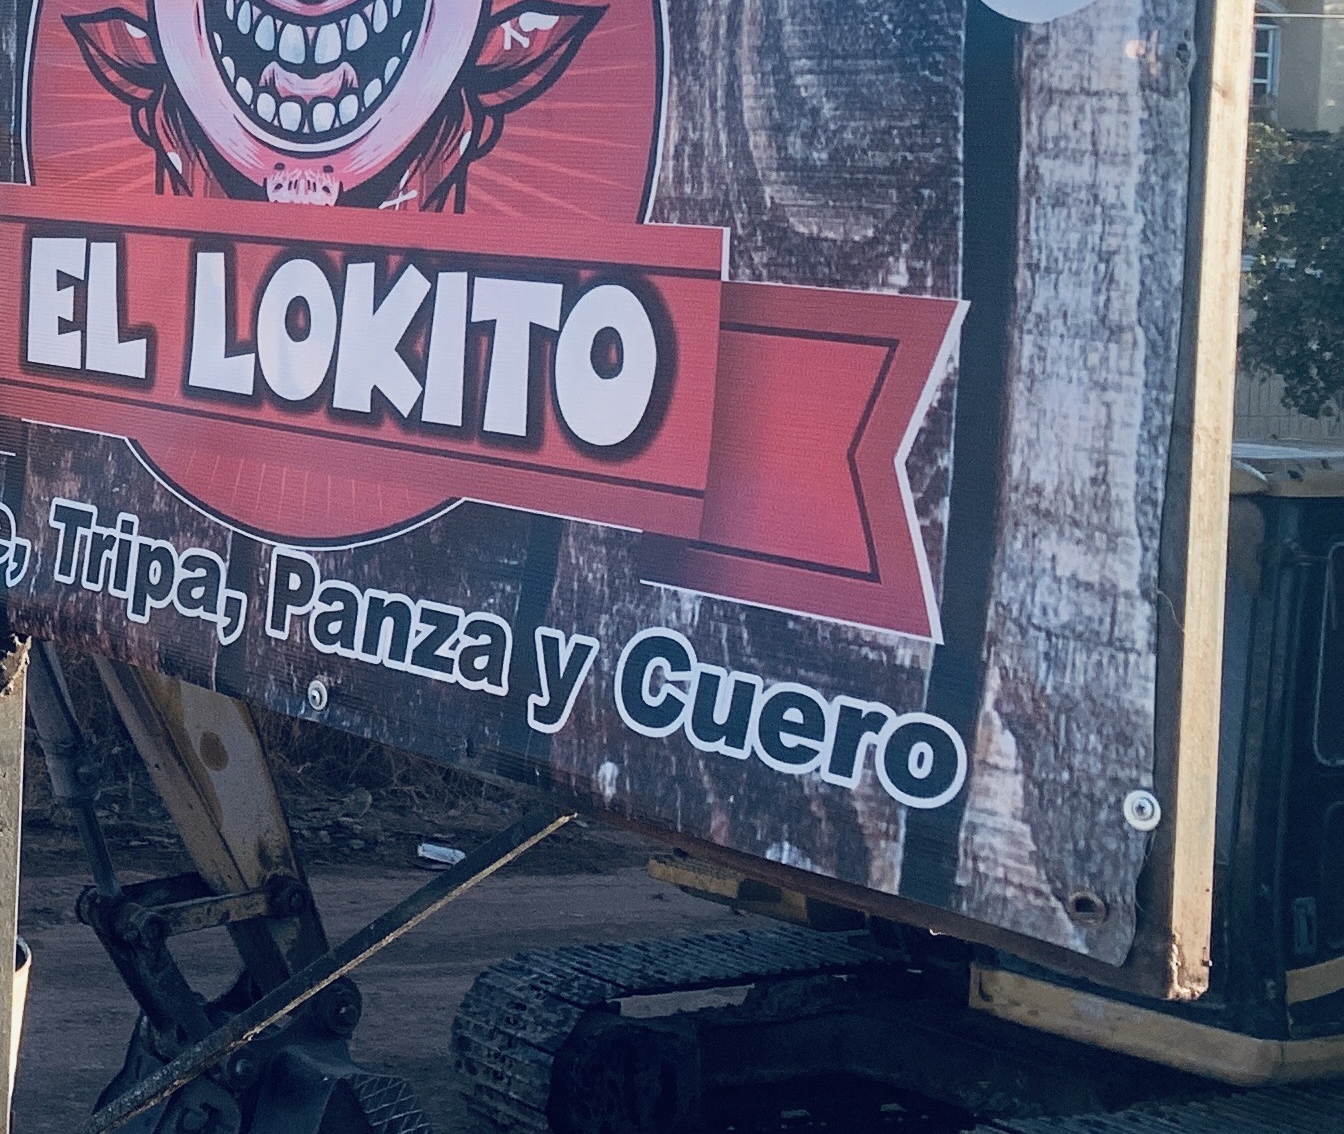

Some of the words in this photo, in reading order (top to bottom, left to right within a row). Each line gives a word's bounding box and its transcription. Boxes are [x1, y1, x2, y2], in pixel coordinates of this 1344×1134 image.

[25, 236, 148, 381] EL
[187, 250, 658, 447] LOKITO
[50, 499, 246, 643] Tripa,
[266, 546, 512, 694] Panza
[527, 629, 598, 732] y
[615, 628, 966, 807] Cuero
